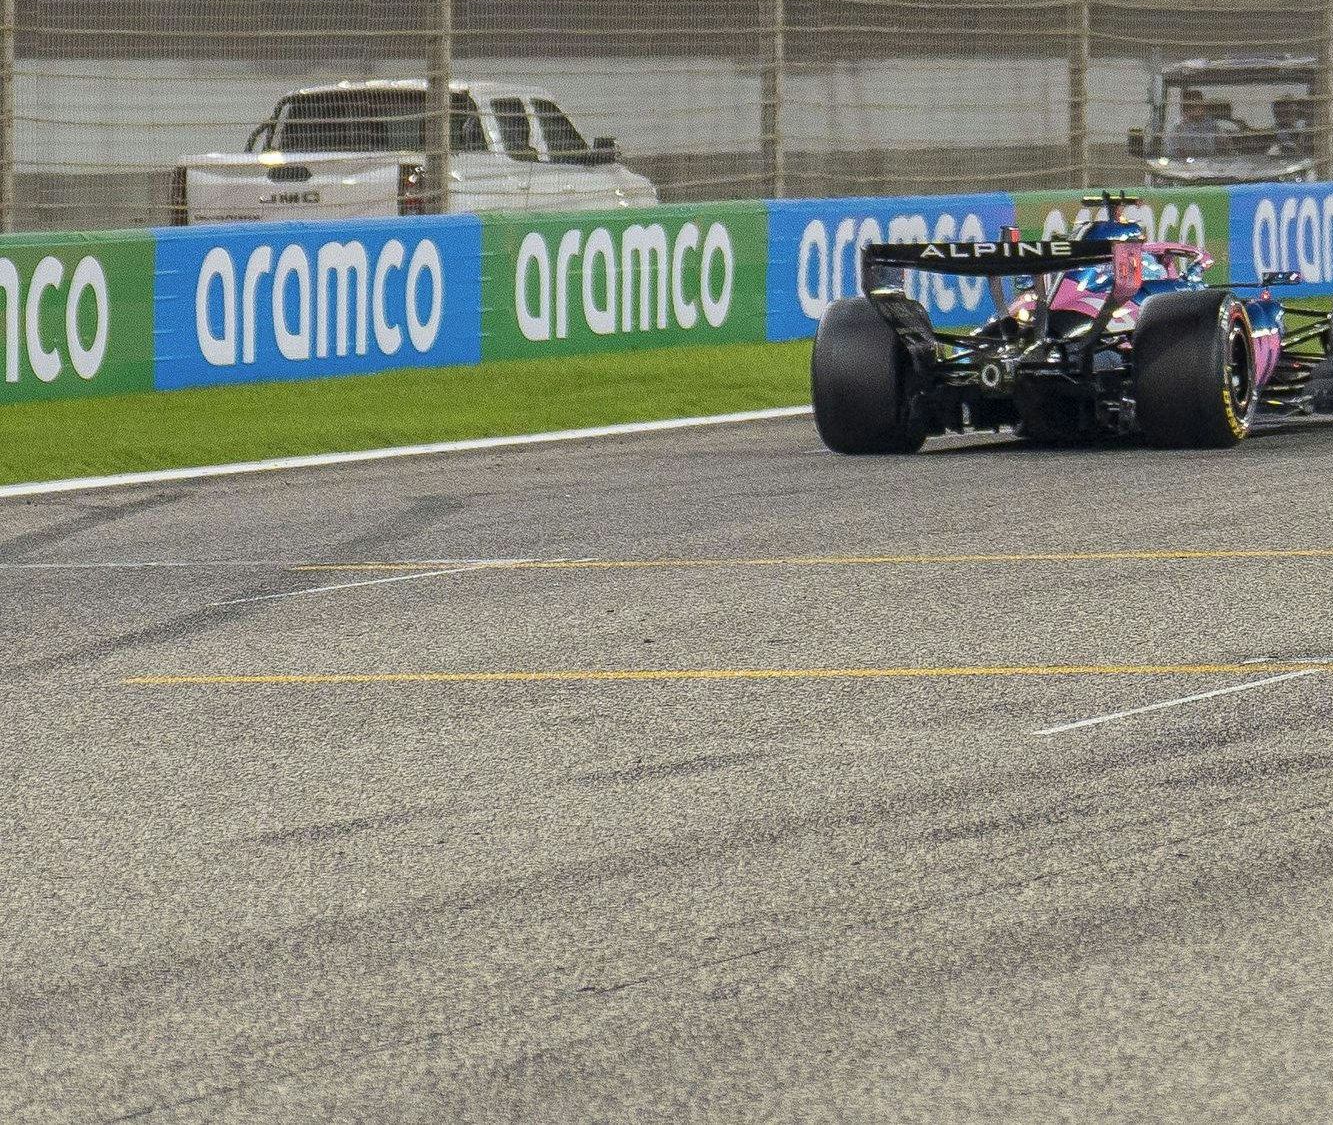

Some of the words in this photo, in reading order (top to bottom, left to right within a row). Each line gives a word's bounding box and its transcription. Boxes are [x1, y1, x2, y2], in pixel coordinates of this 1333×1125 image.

[195, 238, 443, 366] aramco
[515, 222, 734, 342] aramco
[920, 241, 1073, 258] ALPINE
